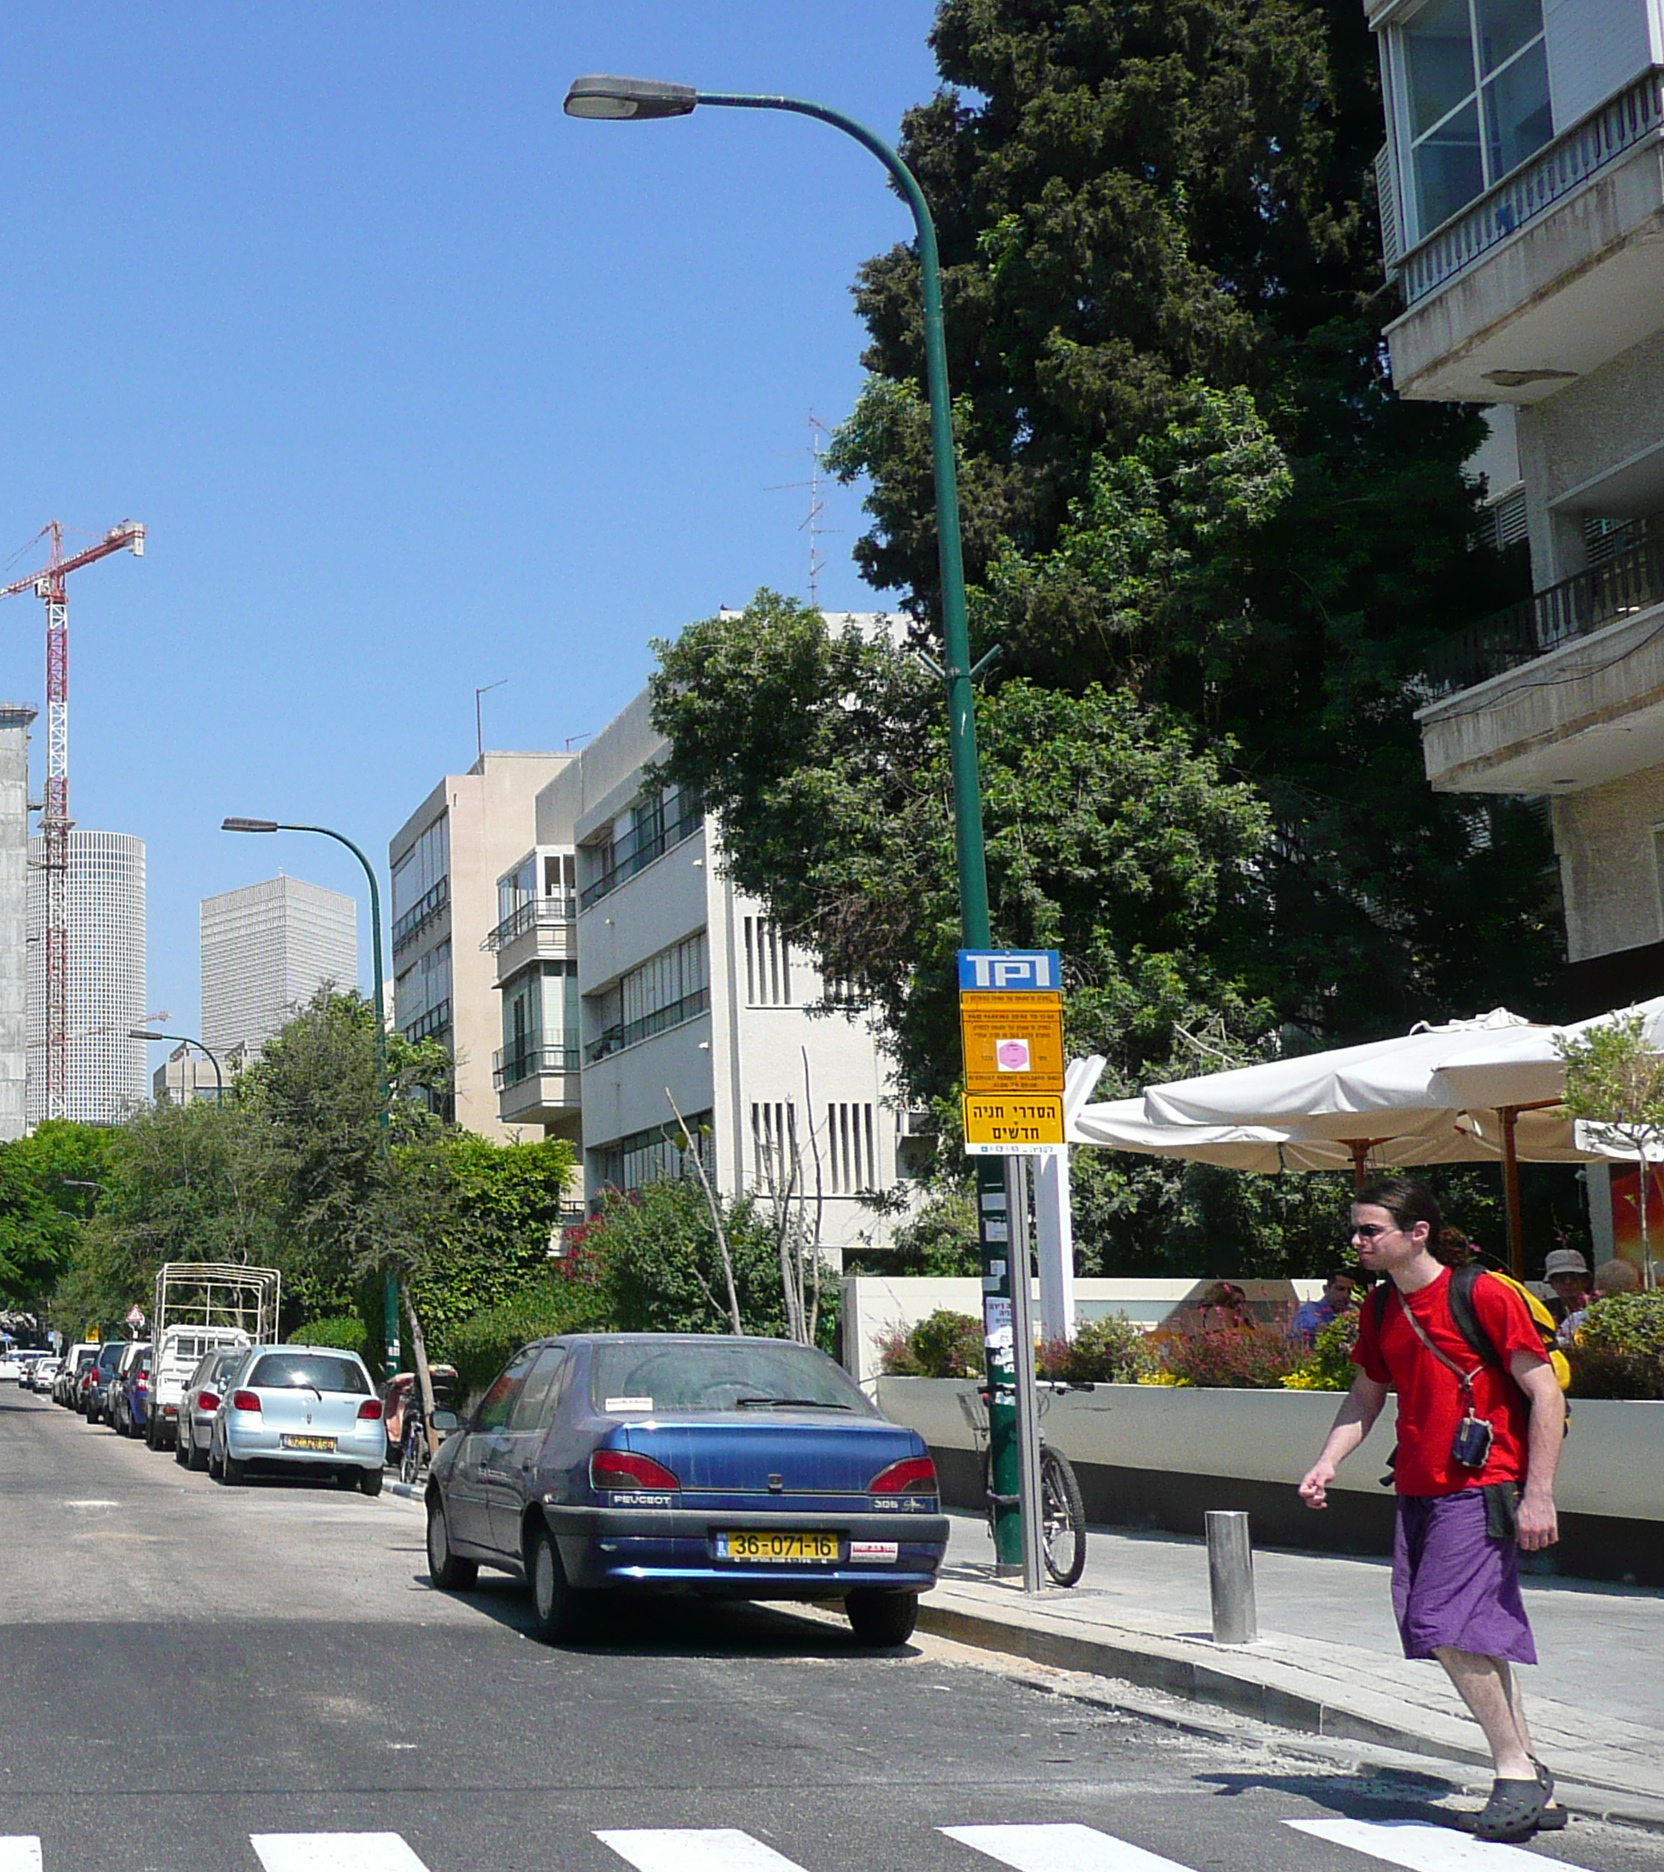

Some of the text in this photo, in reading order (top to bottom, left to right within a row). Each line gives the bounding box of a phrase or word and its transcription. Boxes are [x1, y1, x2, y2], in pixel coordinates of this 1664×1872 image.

[973, 1105, 1056, 1119] הסדרי חניה
[992, 1126, 1040, 1140] חדשים
[614, 1495, 672, 1505] PEUGEOT
[734, 1535, 832, 1556] 36-071-16
